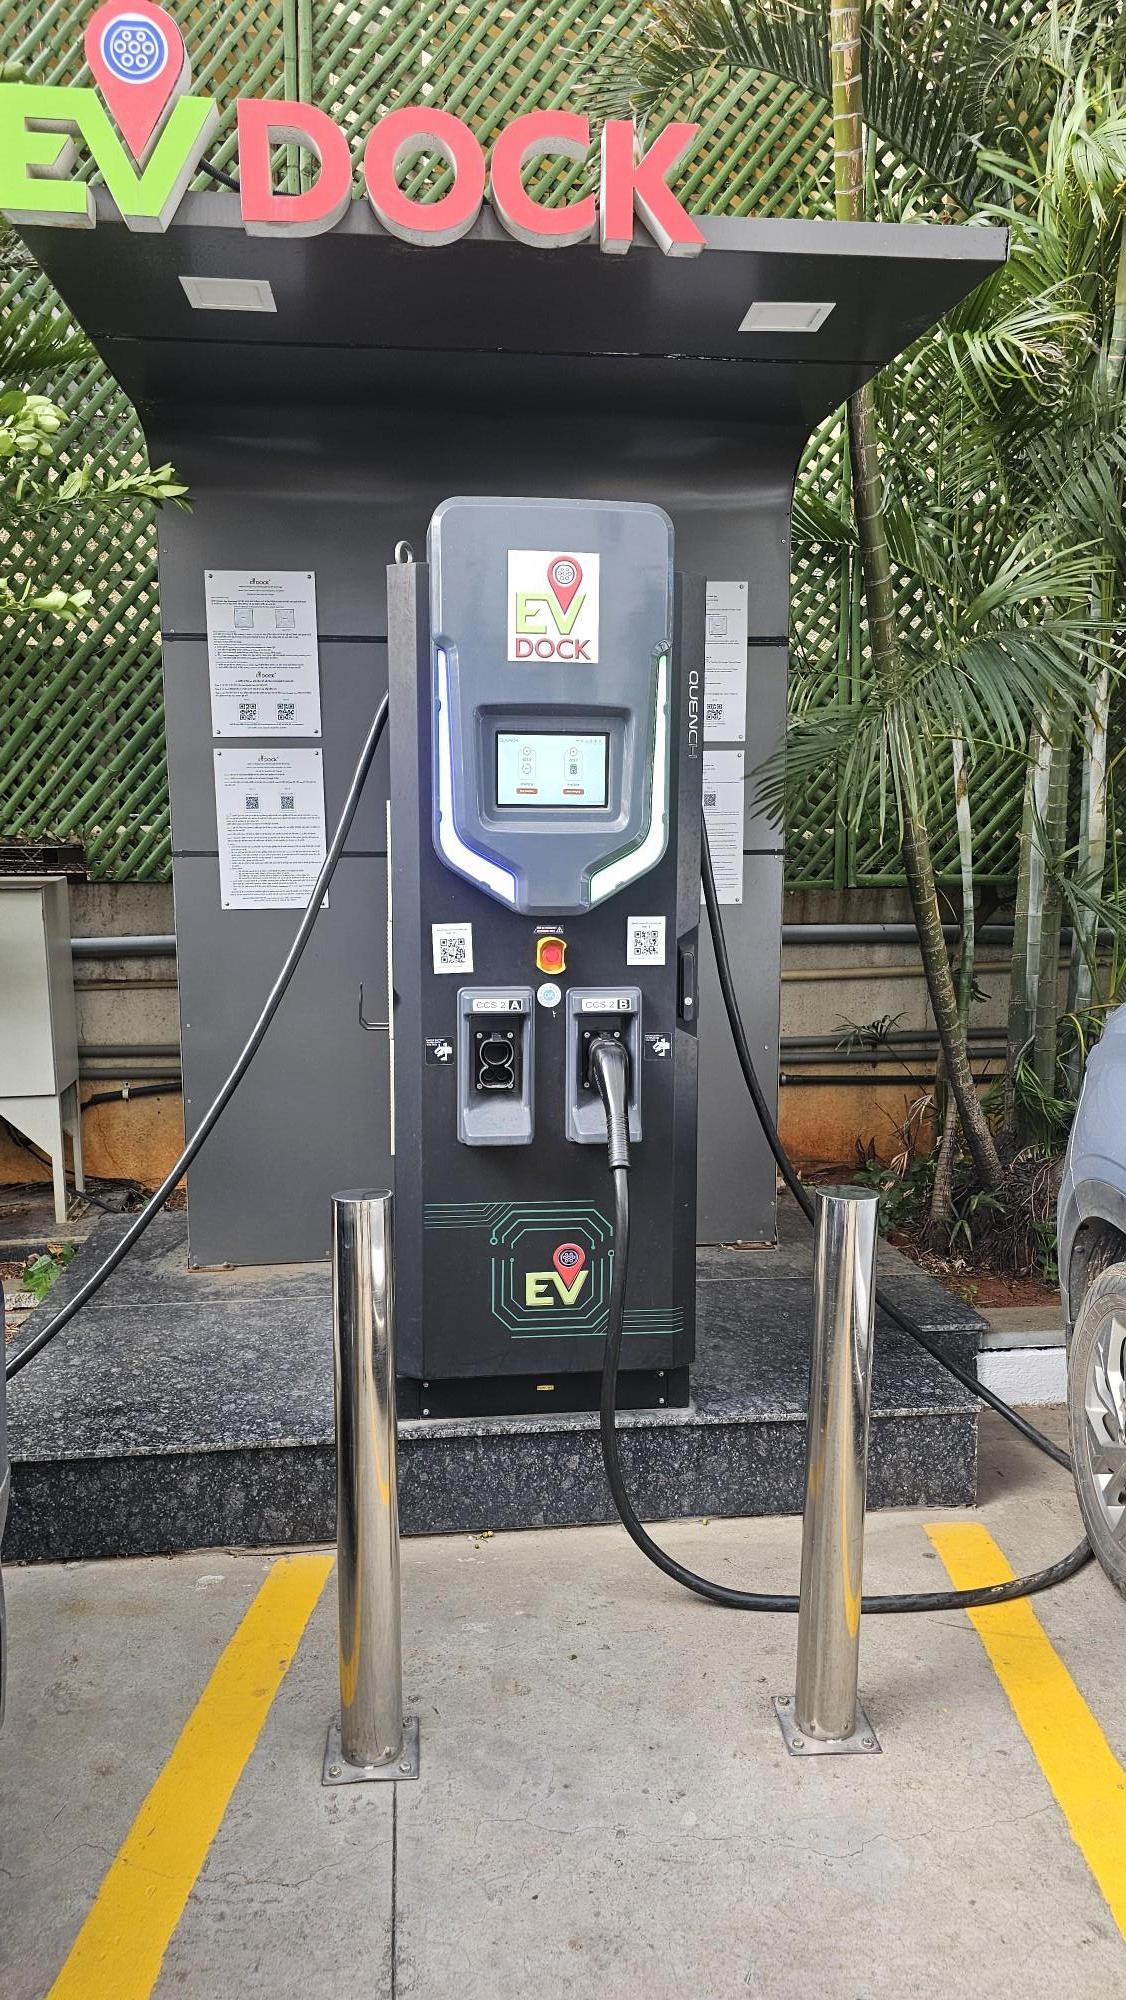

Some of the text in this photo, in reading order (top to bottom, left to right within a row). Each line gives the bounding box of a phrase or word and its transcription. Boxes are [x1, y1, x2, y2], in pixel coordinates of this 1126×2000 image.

[0, 82, 709, 256] EV DOCK
[515, 591, 587, 635] EV
[515, 637, 591, 660] DOCK
[688, 670, 699, 759] QUENCH
[476, 1000, 521, 1010] CCS 2 A
[585, 999, 629, 1009] CCS 2 B
[525, 1270, 589, 1306] EV
